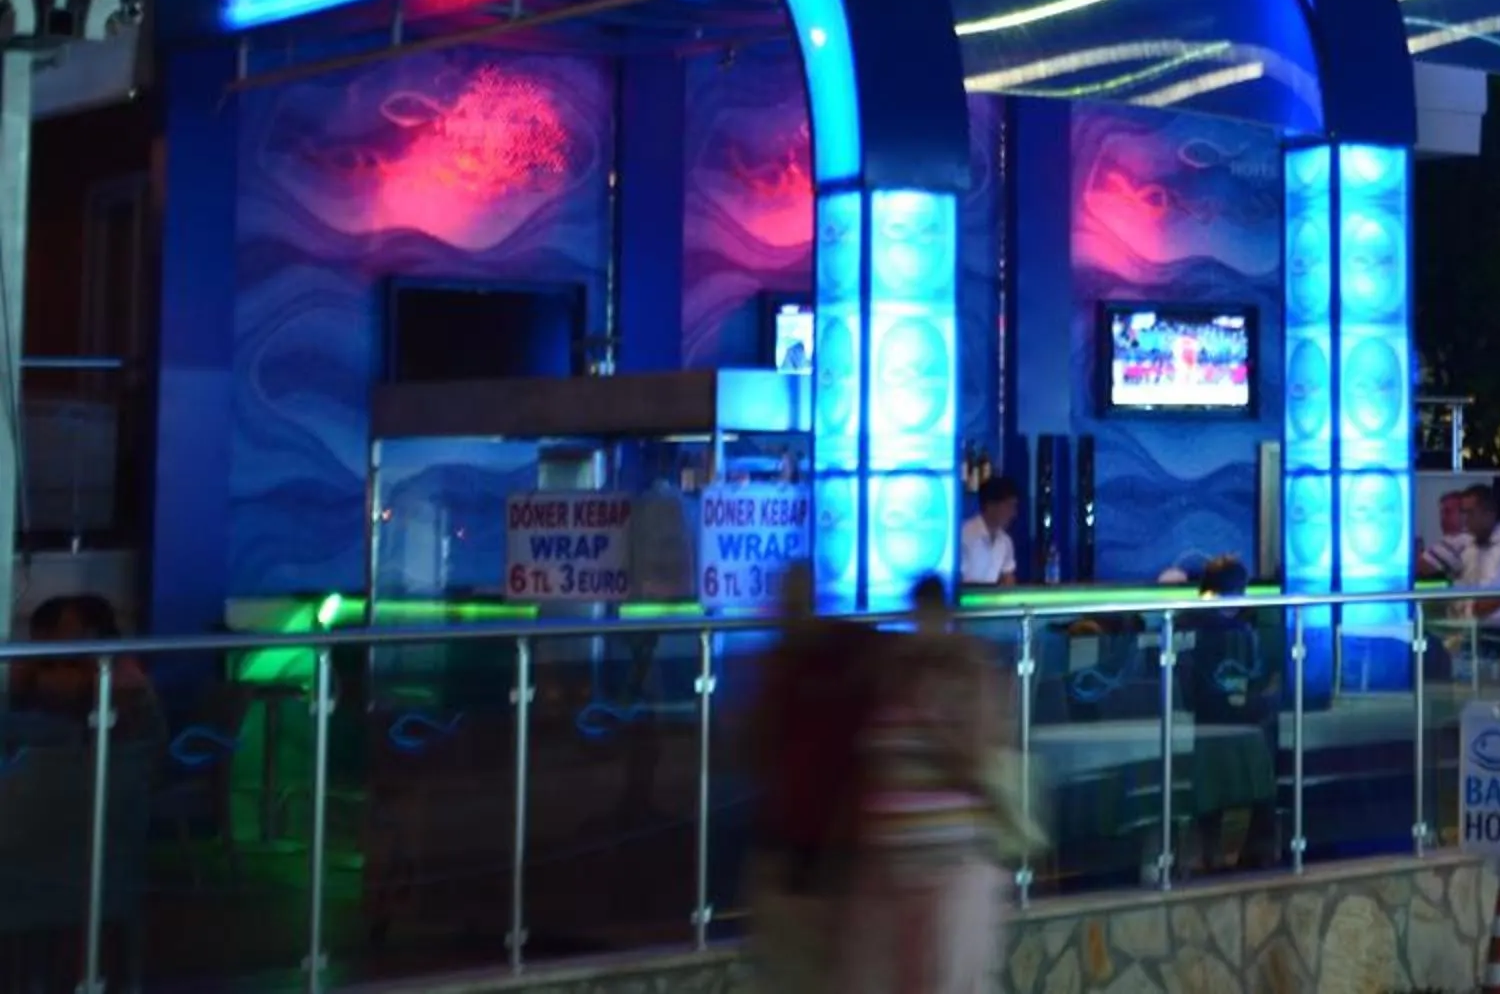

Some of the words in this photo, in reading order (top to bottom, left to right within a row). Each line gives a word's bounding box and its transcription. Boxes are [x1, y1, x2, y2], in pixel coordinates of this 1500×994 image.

[573, 499, 631, 528] KEBAP
[760, 498, 807, 527] KEBAP
[529, 535, 609, 561] WRAP
[717, 534, 799, 561] WRAP
[509, 563, 527, 594] 6
[530, 570, 552, 594] TL
[559, 563, 575, 594] 3
[578, 570, 628, 595] EURO
[704, 566, 719, 597] 6
[724, 573, 741, 596] TL
[749, 565, 763, 597] 3
